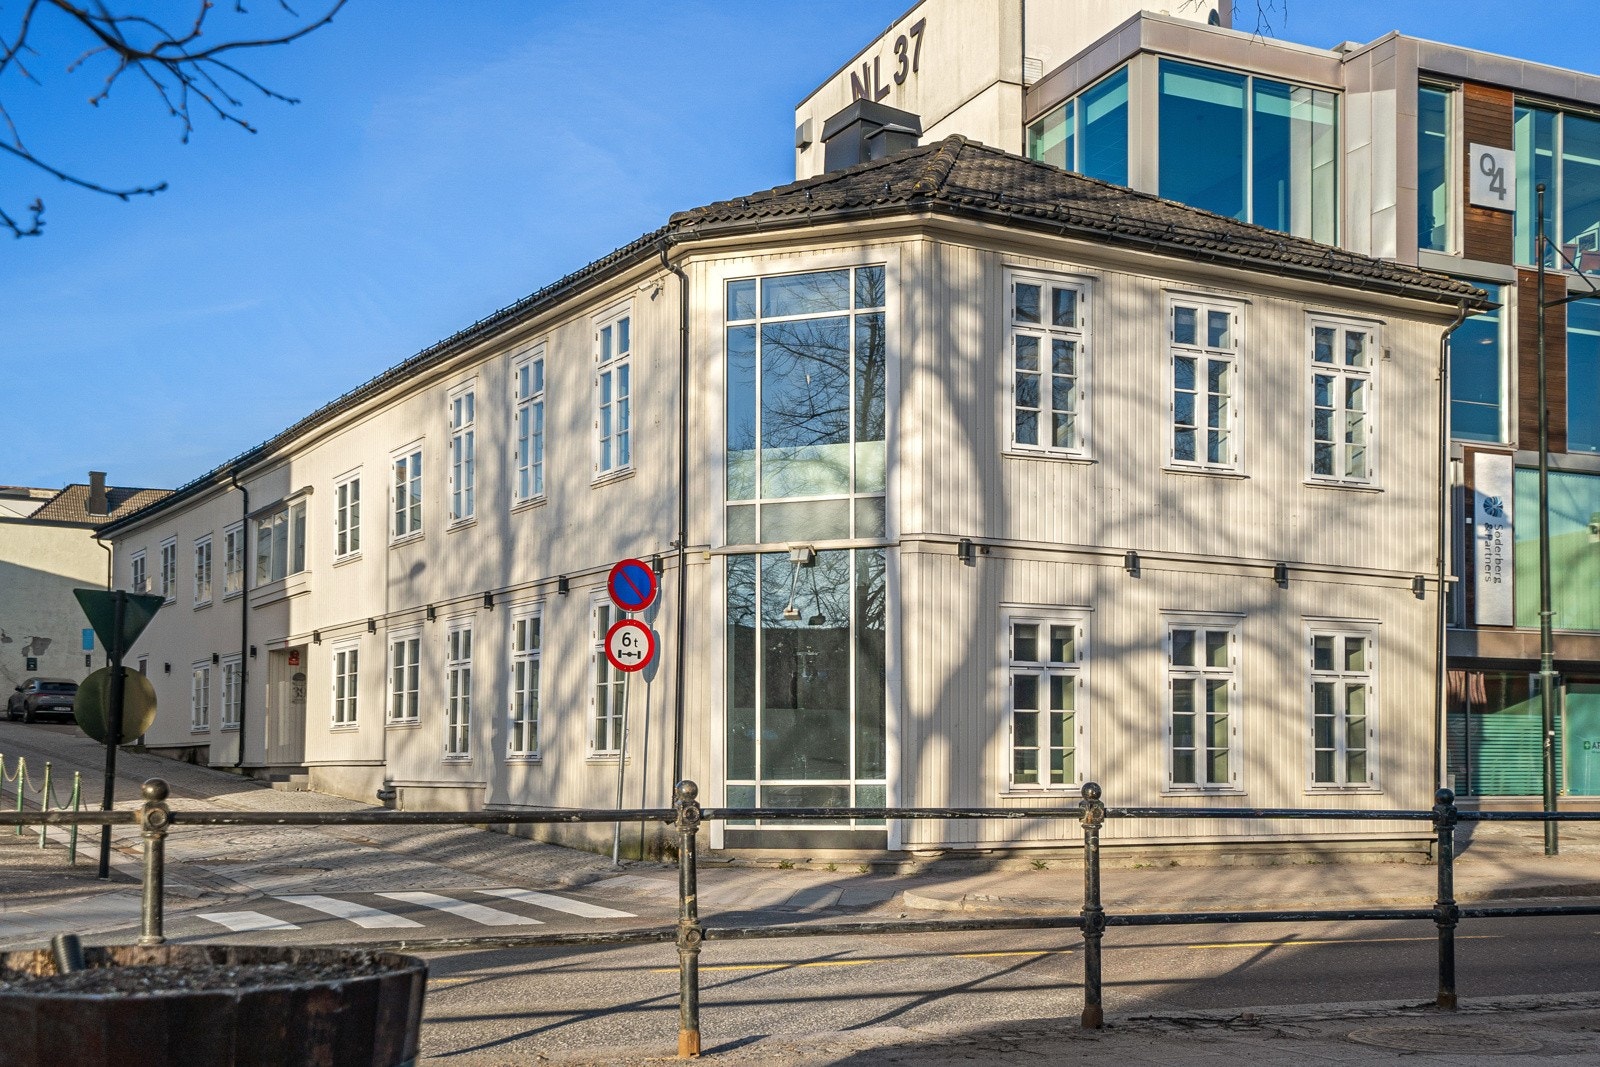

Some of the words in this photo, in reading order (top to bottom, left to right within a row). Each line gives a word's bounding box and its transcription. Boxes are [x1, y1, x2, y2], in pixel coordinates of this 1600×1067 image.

[850, 55, 890, 102] NL
[893, 17, 926, 85] 37
[1485, 523, 1493, 531] &
[1494, 524, 1503, 583] Söderberg
[1485, 534, 1493, 582] Partners
